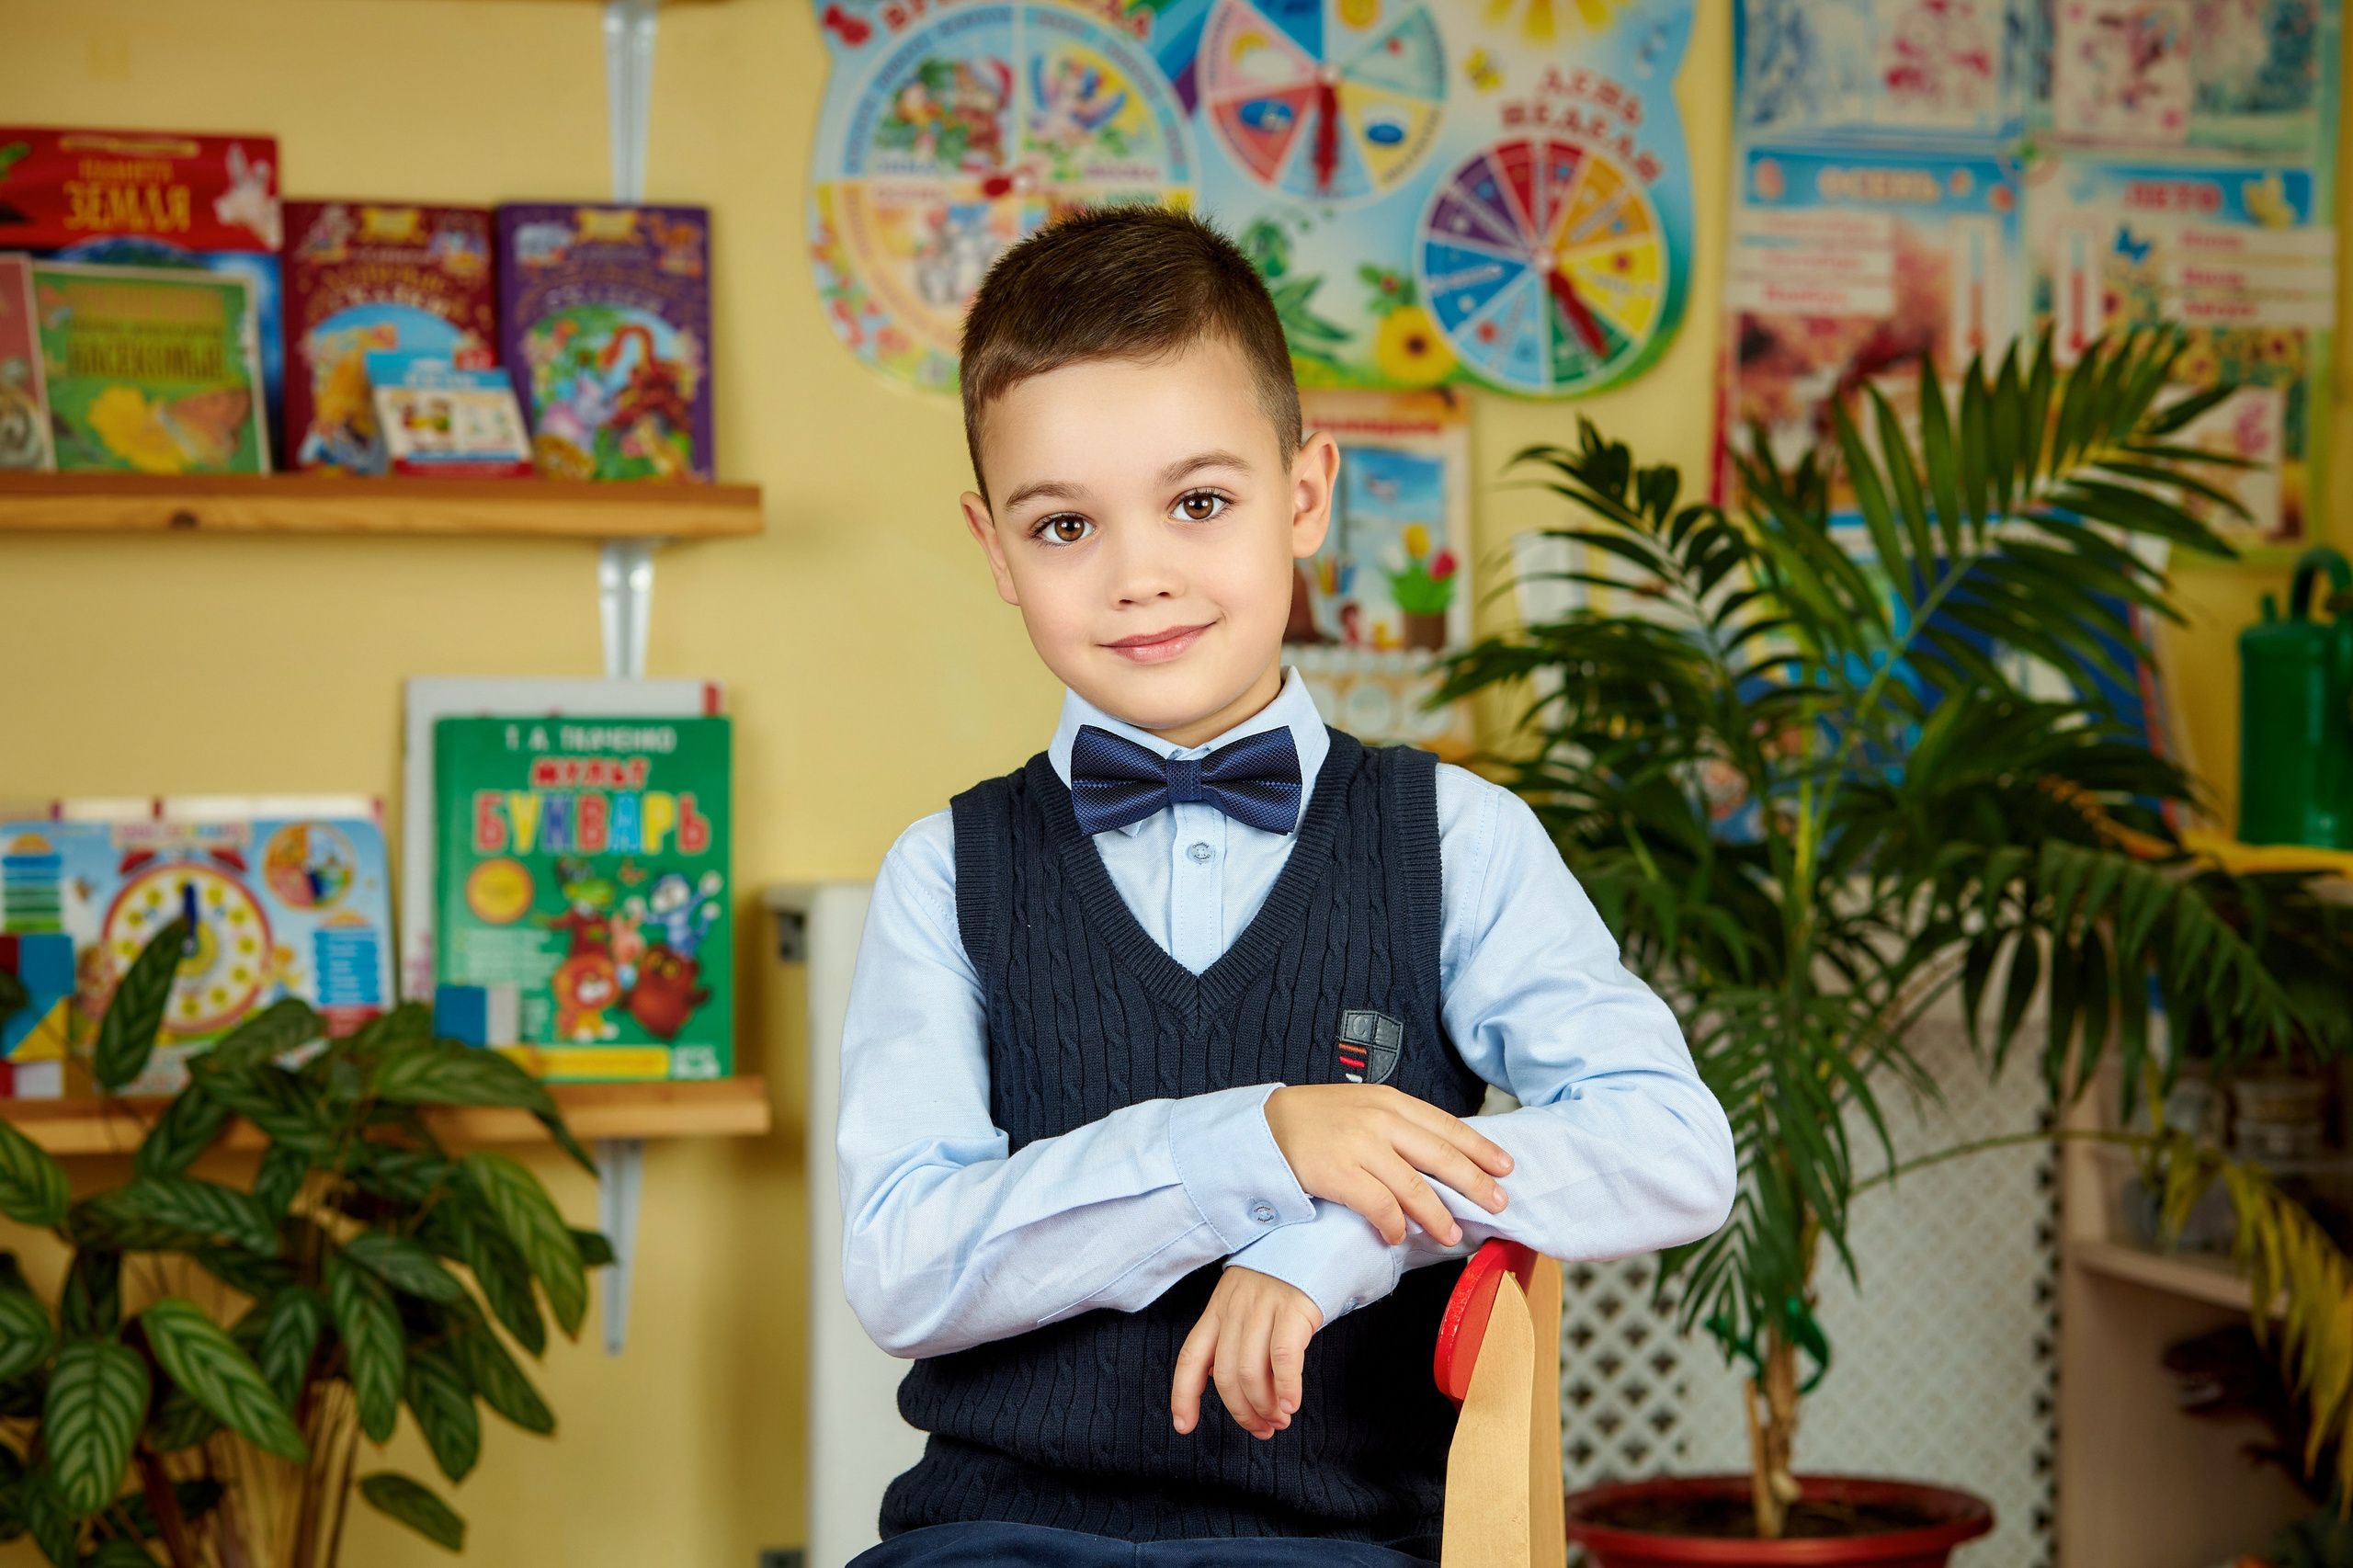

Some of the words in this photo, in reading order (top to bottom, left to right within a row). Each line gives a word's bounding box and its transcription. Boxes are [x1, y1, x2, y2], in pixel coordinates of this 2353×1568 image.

[63, 179, 191, 233] ЗЕМЛЯ
[529, 756, 651, 790] МУЛЬТ
[472, 789, 712, 856] БУКВАРЬ
